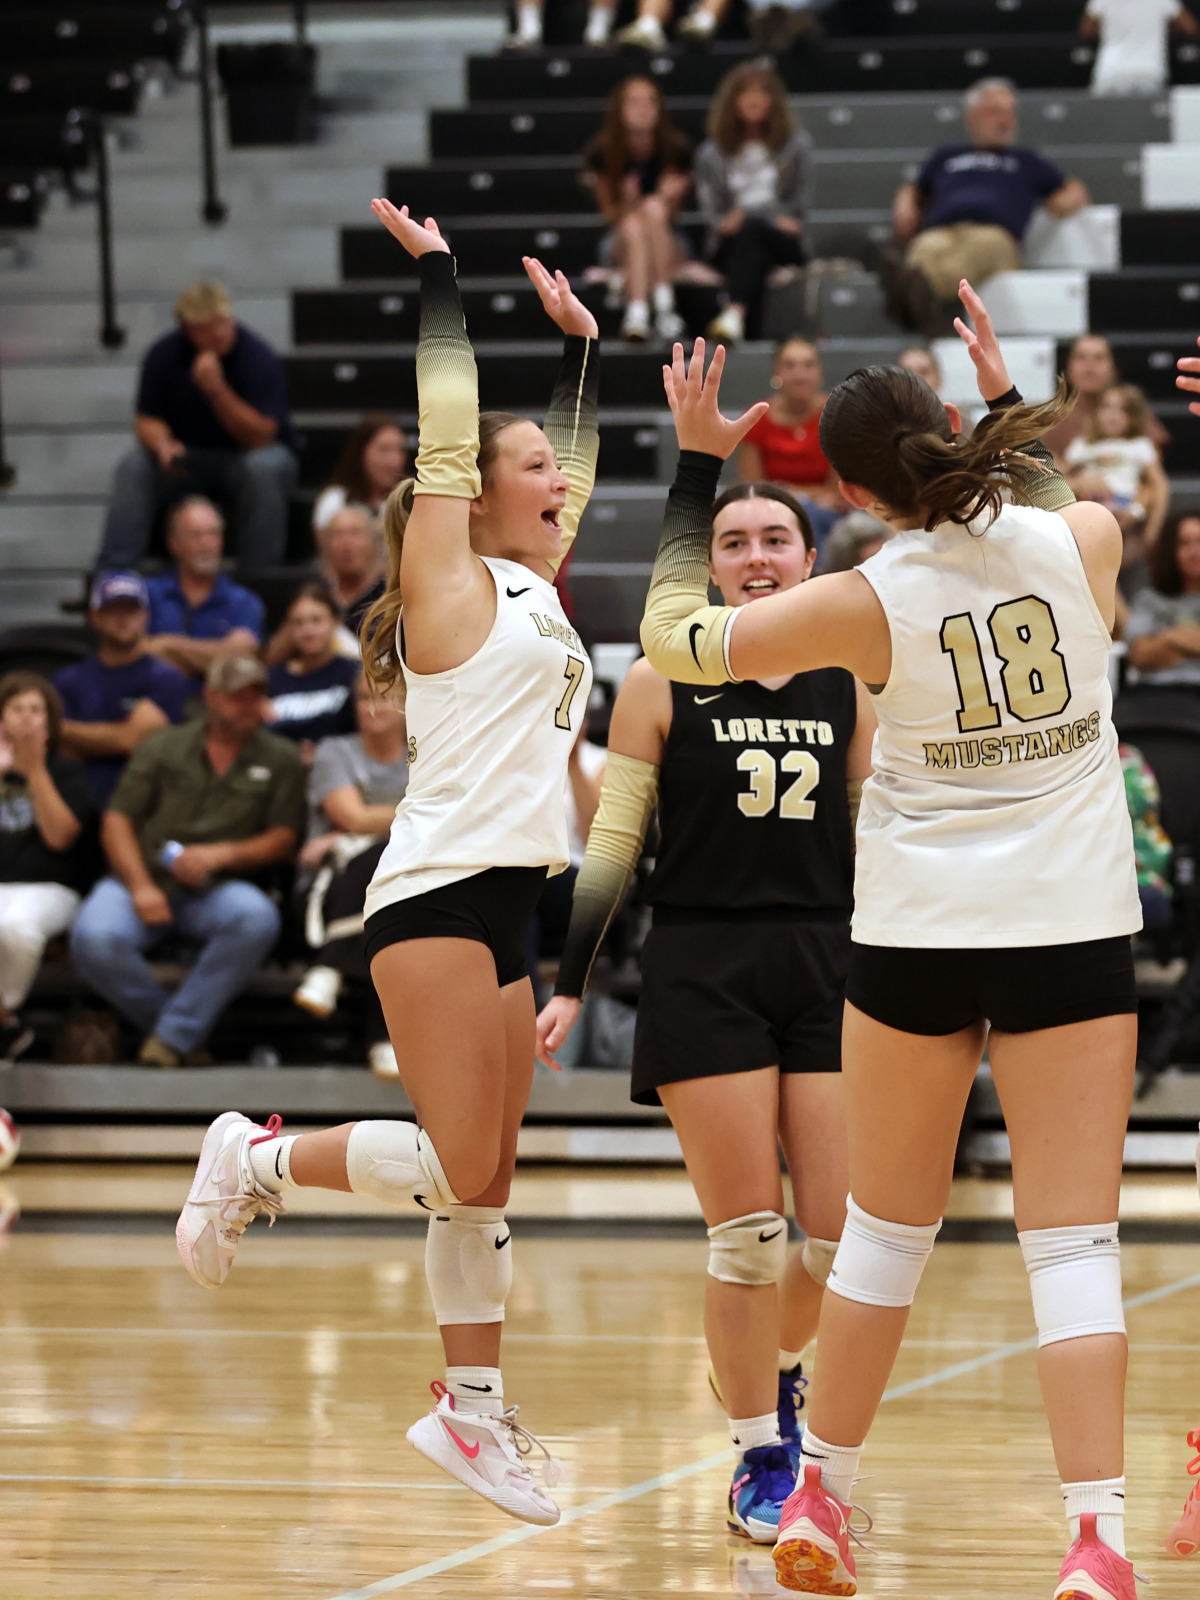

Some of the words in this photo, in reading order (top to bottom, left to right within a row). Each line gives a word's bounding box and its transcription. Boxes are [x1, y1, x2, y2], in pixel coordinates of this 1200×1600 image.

[554, 653, 585, 731] 7
[939, 594, 1072, 734] 18
[711, 718, 835, 746] LORETTO
[922, 710, 1101, 769] MUSTANGS
[736, 749, 820, 820] 32
